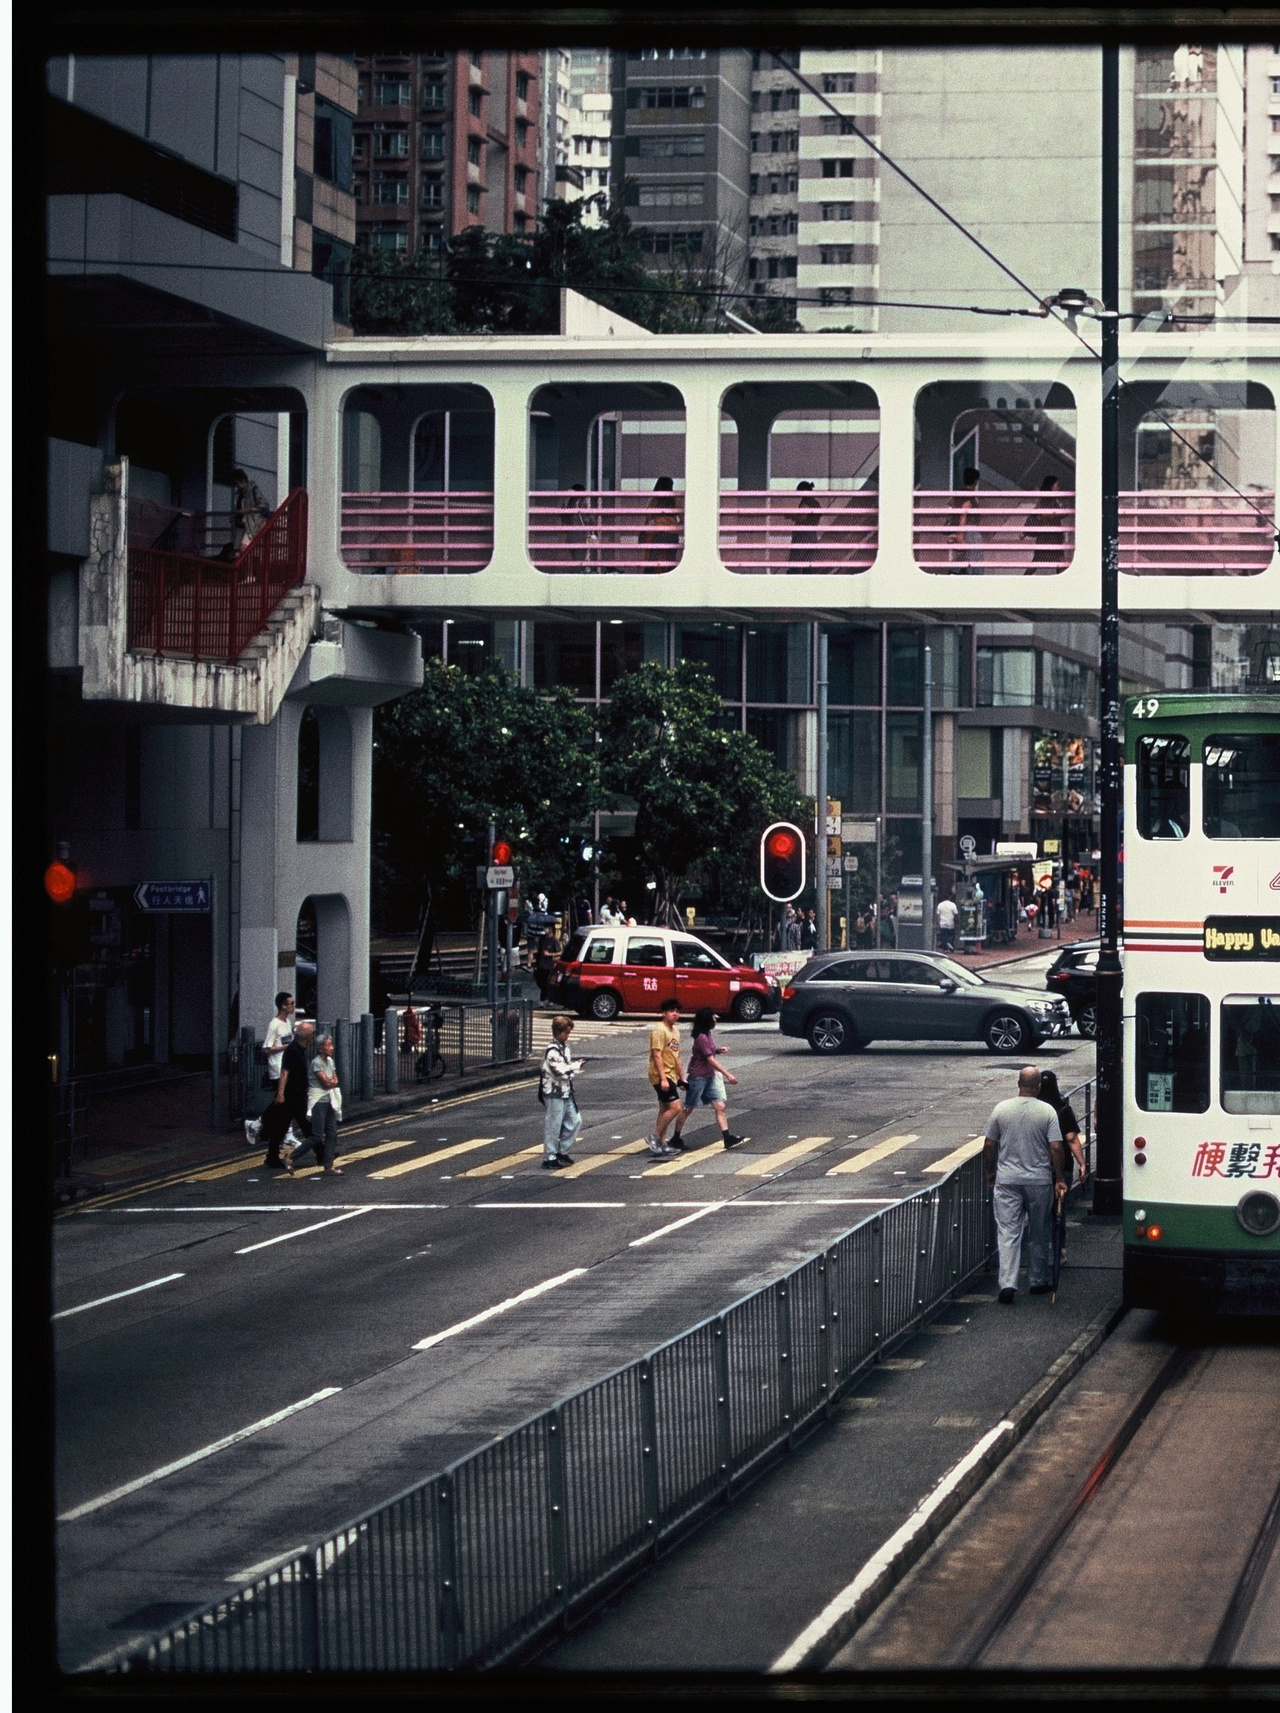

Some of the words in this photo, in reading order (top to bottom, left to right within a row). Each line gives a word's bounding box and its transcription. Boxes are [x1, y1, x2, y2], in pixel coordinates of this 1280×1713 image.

[1132, 699, 1160, 719] 49
[150, 884, 192, 893] Footbridge
[1204, 927, 1255, 951] Happy
